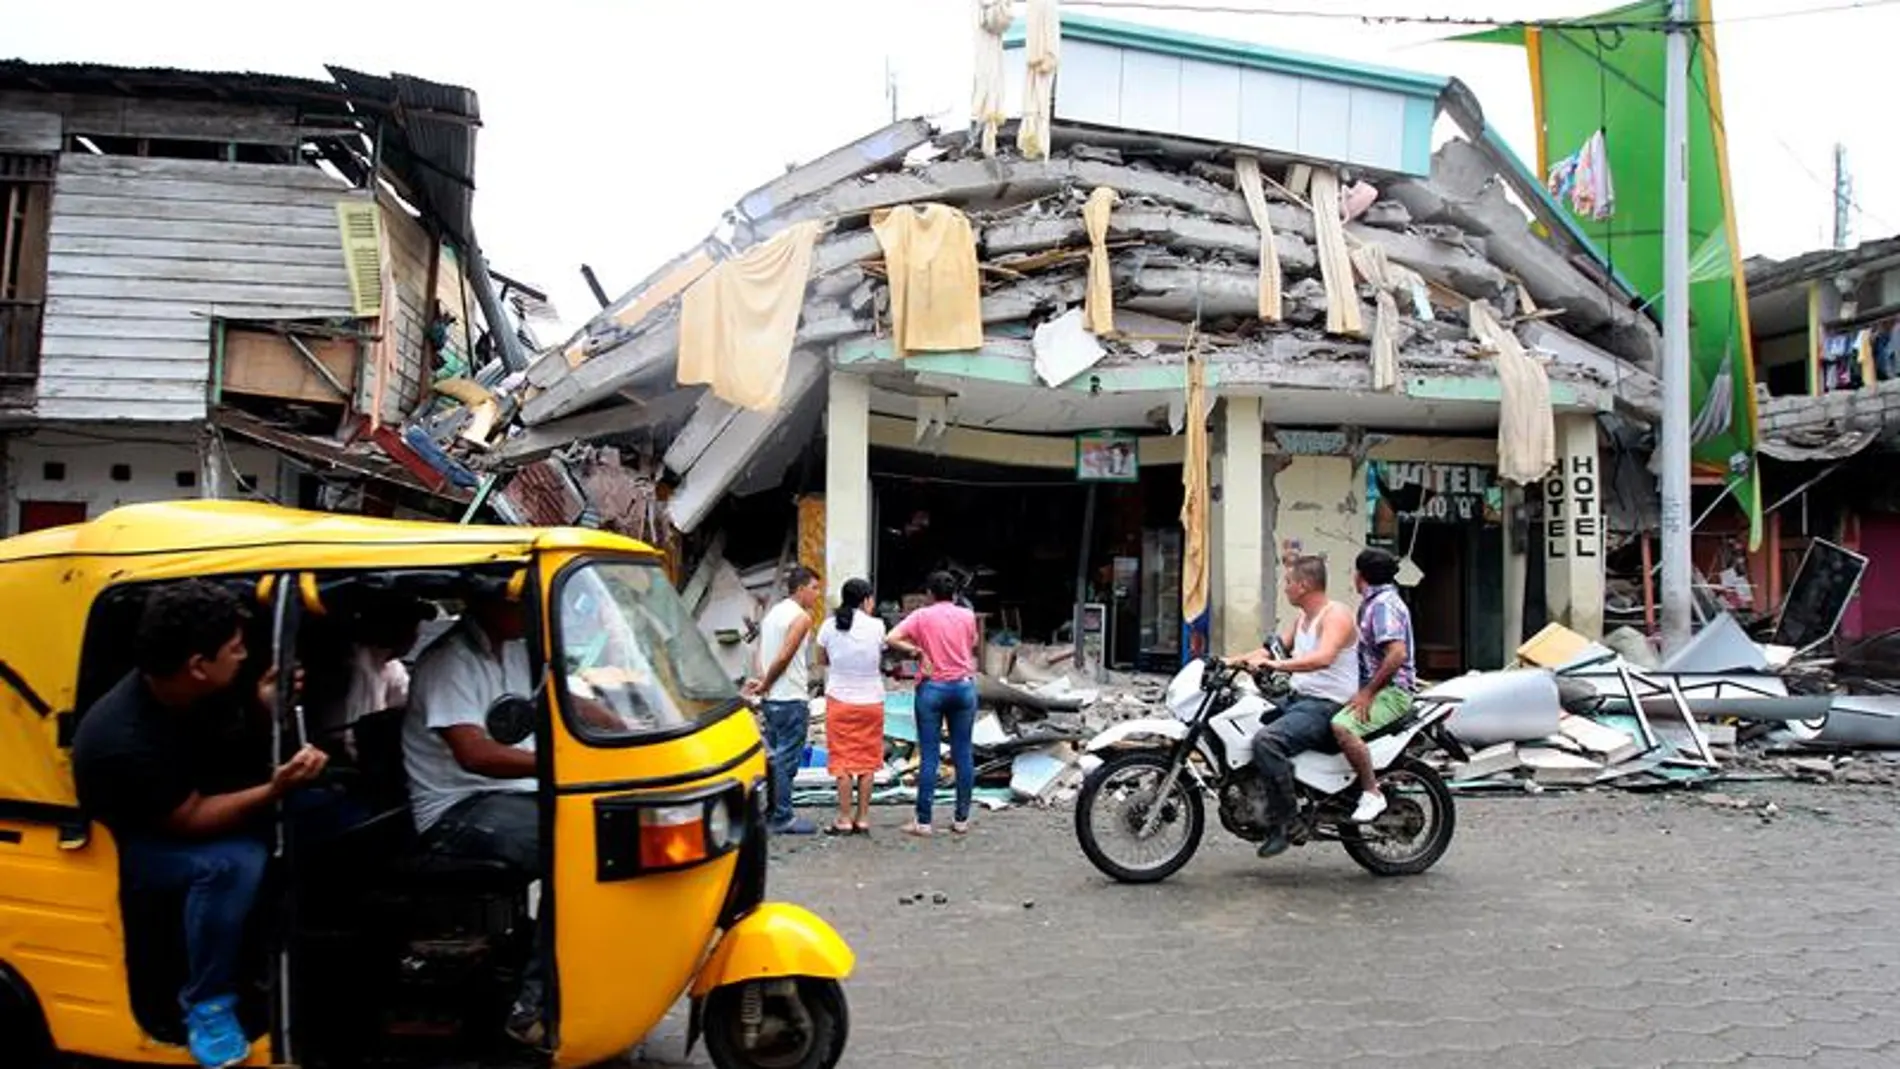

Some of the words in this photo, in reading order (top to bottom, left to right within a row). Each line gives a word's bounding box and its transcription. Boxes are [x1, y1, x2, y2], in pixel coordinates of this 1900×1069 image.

[1388, 463, 1483, 493] HOTEL
[1547, 458, 1565, 558] HOTEL
[1573, 456, 1596, 557] HOTEL
